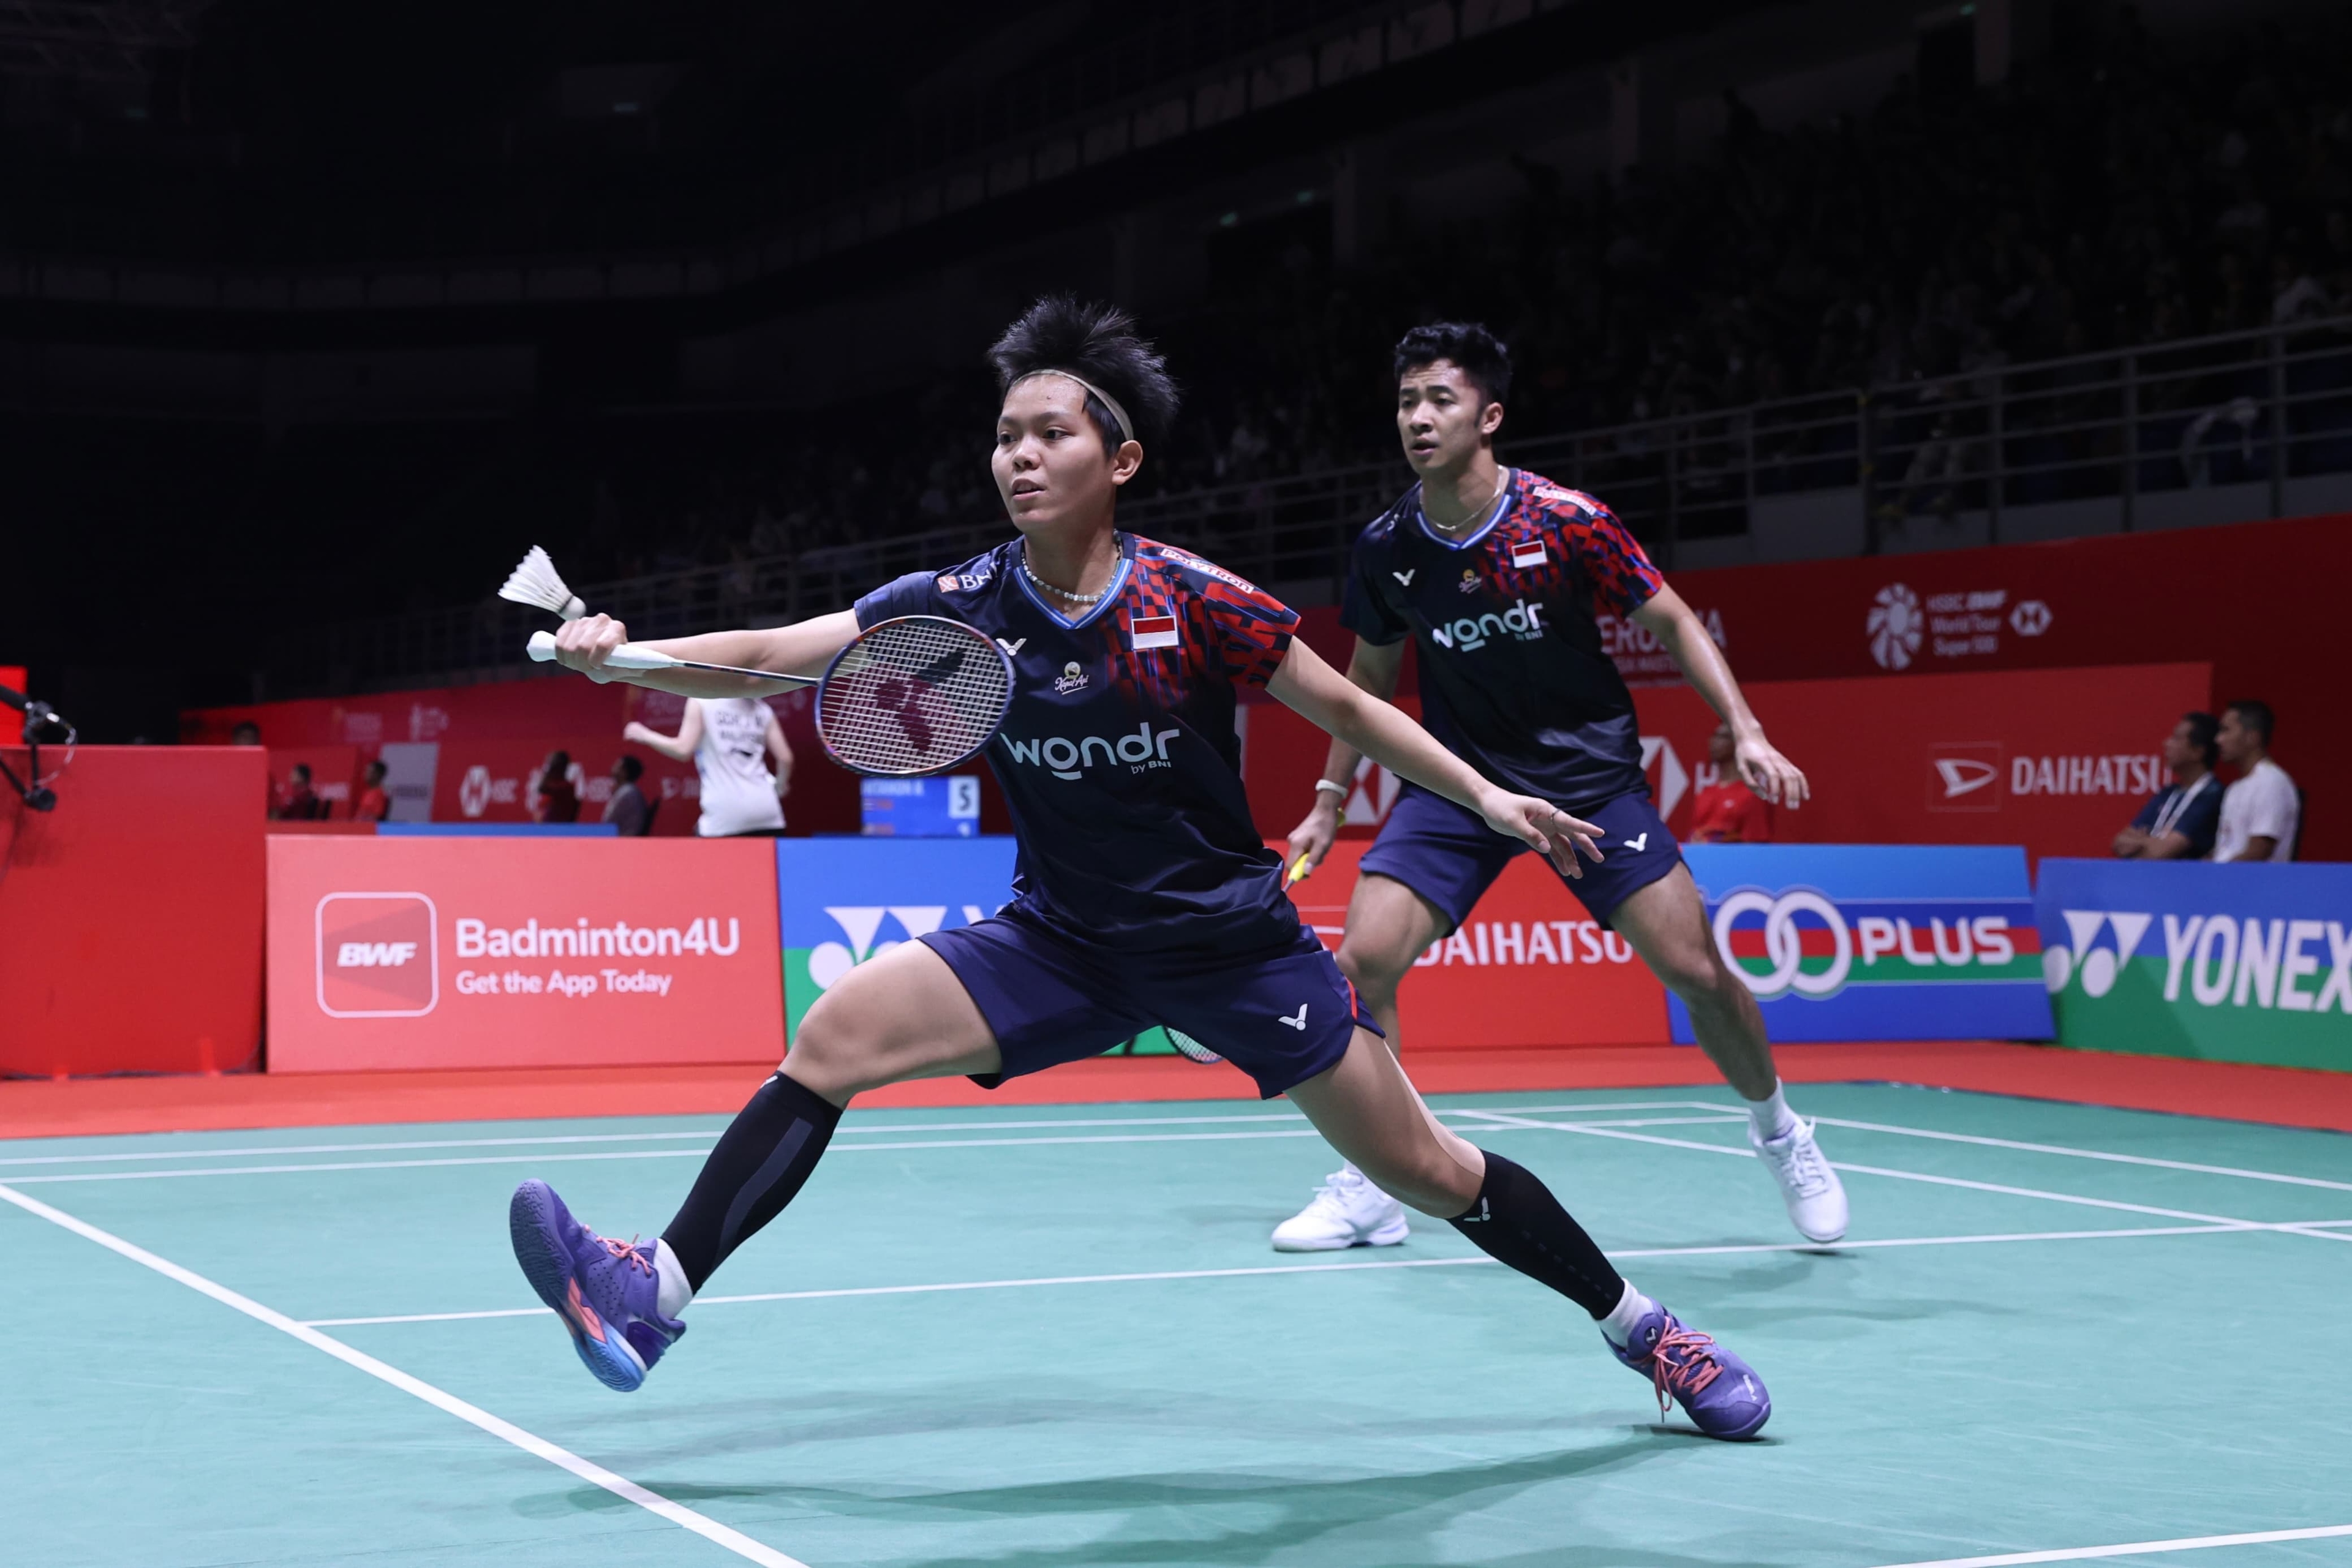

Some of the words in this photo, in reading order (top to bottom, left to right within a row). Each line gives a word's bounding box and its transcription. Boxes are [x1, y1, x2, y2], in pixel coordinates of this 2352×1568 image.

[1000, 722, 1180, 780] wondr
[1130, 764, 1145, 775] by
[1147, 760, 1172, 769] BNI
[337, 942, 417, 967] BWF
[456, 918, 739, 957] Badminton4U
[1858, 916, 2015, 967] PLUS
[2163, 913, 2352, 1012] YONEX
[456, 971, 500, 994] Get
[503, 970, 543, 993] the
[546, 969, 598, 998] App
[600, 968, 673, 997] Today
